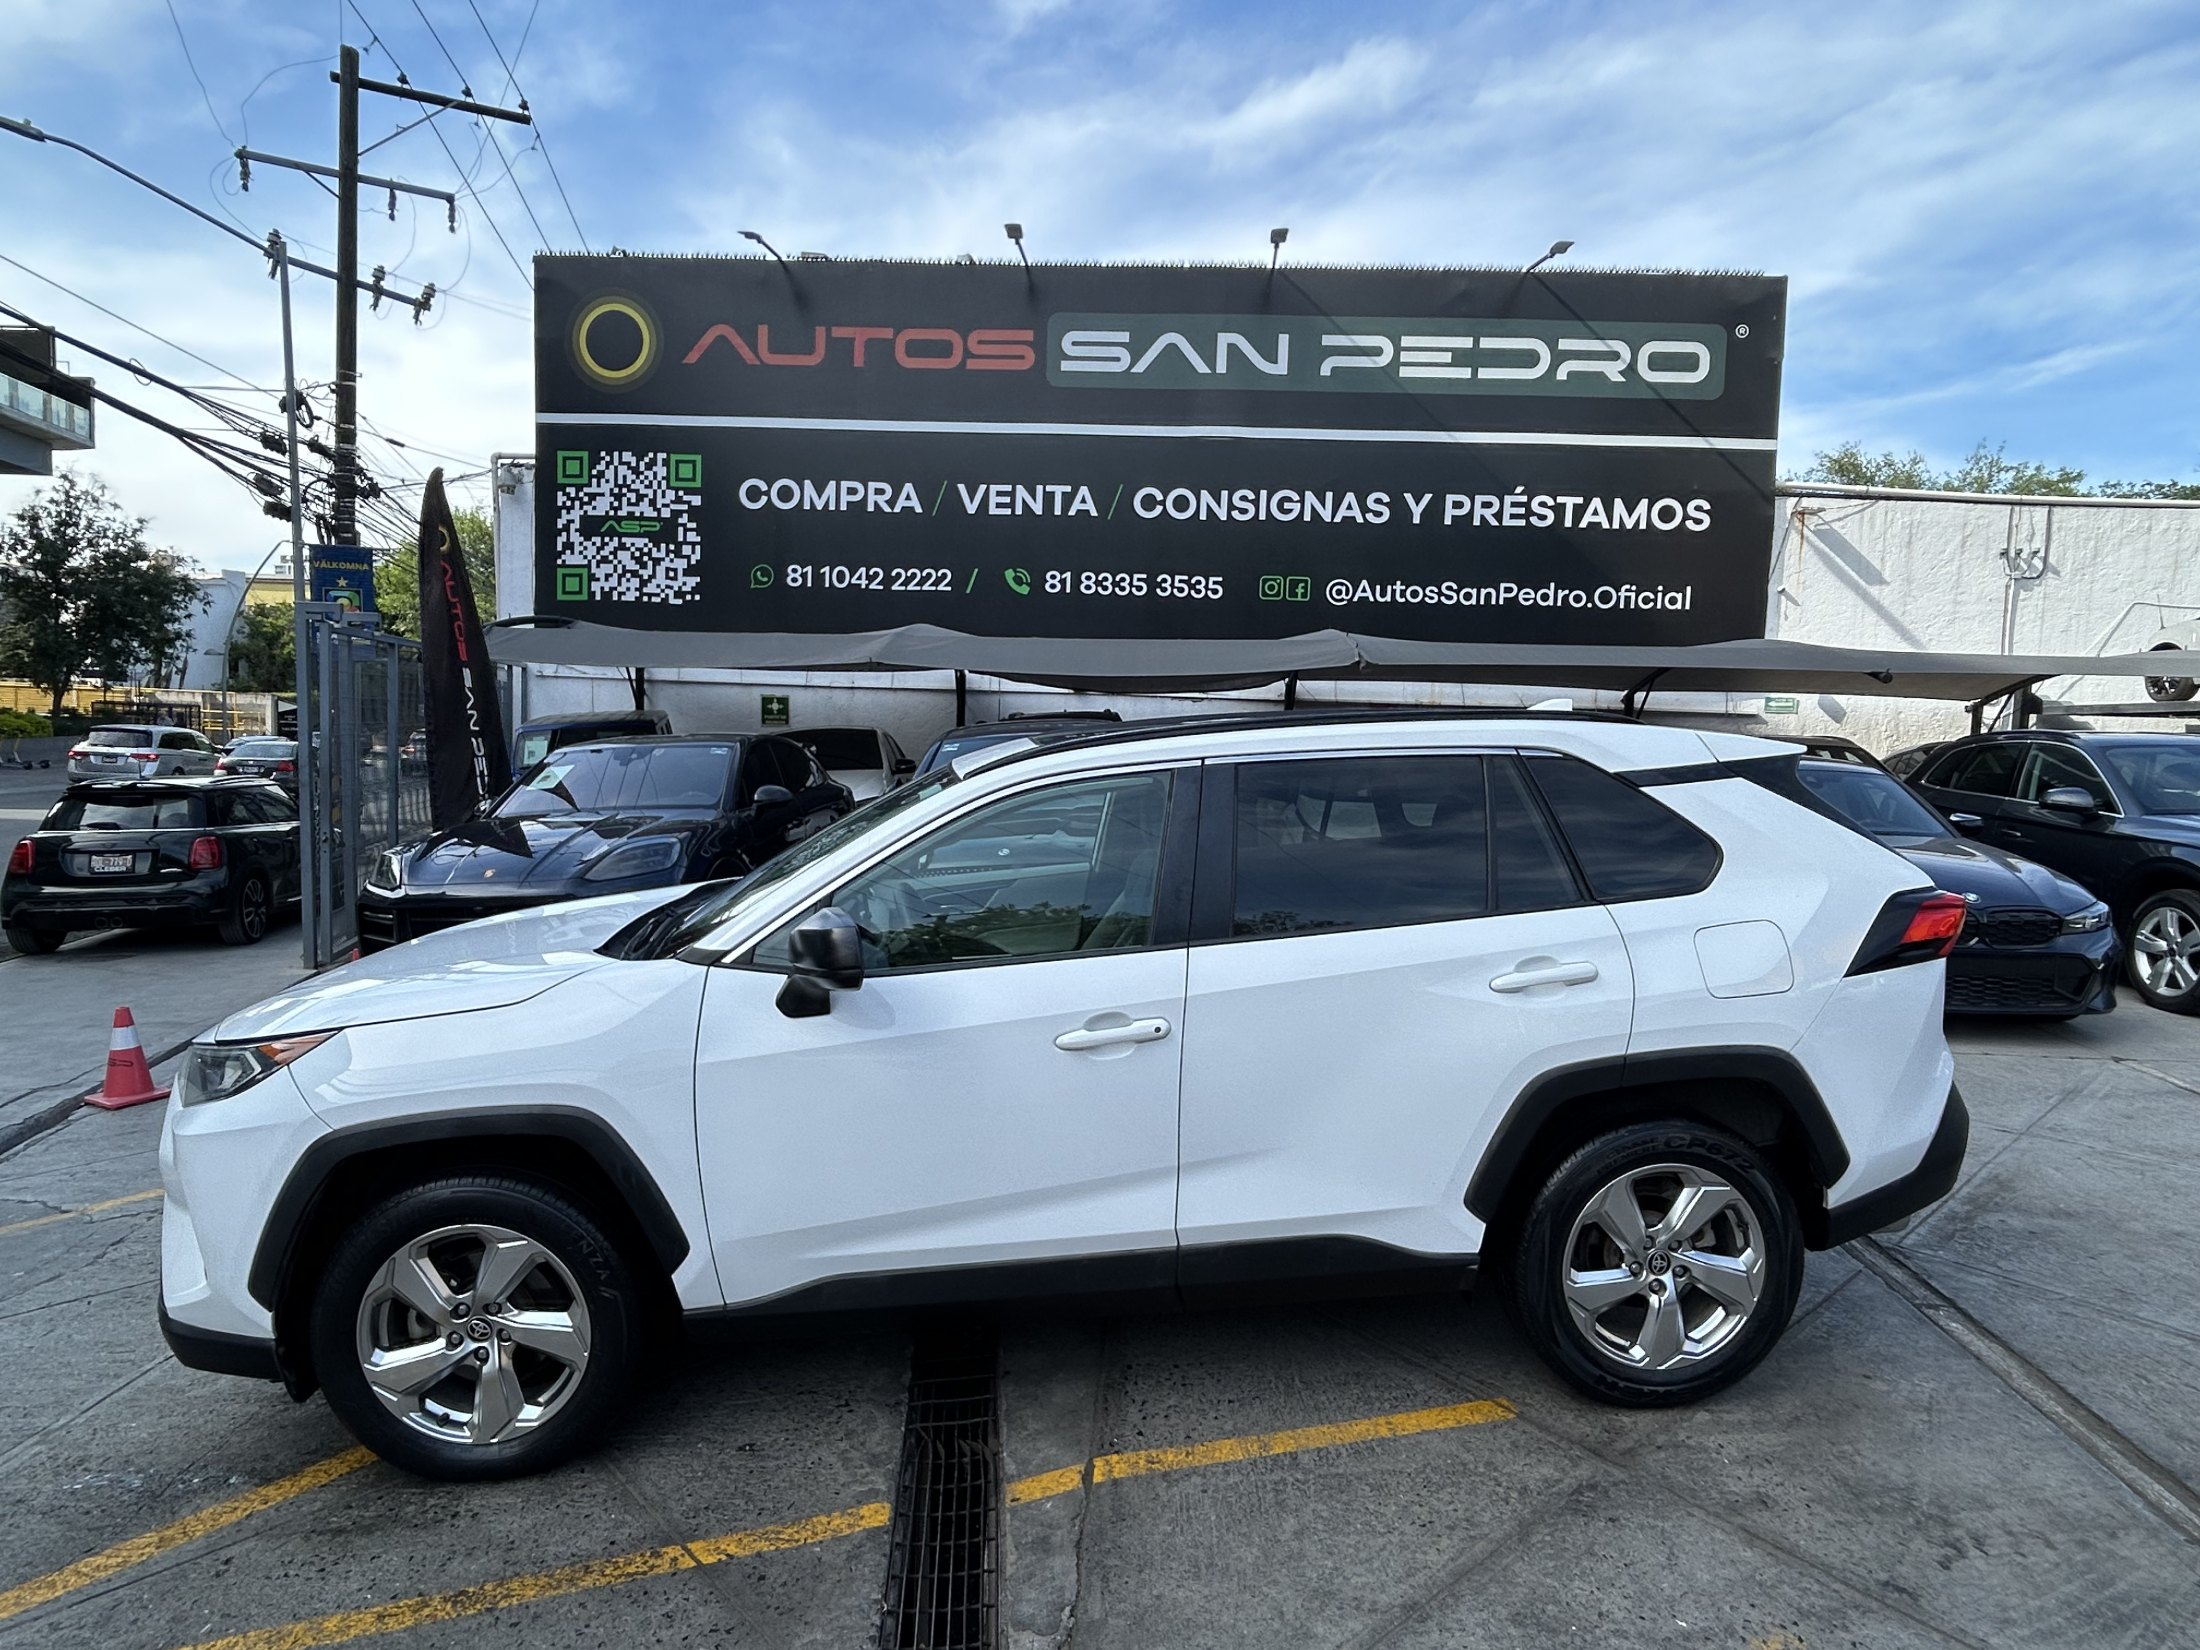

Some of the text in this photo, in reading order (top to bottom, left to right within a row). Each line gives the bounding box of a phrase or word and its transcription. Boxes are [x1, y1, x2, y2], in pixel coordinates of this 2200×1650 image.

[682, 324, 1036, 370] AUTOS
[1060, 330, 1290, 375] SAN
[1319, 334, 1711, 384] PEDRO
[738, 477, 924, 514] COMPRA
[956, 483, 1099, 518] VENTA
[1132, 486, 1391, 525] CONSIGNAS
[1403, 492, 1434, 526] Y
[1443, 485, 1713, 533] PRÉSTAMOS
[600, 518, 662, 534] ASP
[786, 564, 813, 588] 81
[819, 565, 884, 590] 1042
[890, 567, 952, 592] 2222
[1044, 570, 1224, 600] 81 8335 3535
[1325, 578, 1692, 611] @AutosSanPedro.Oficial
[440, 560, 468, 661] AUTOS
